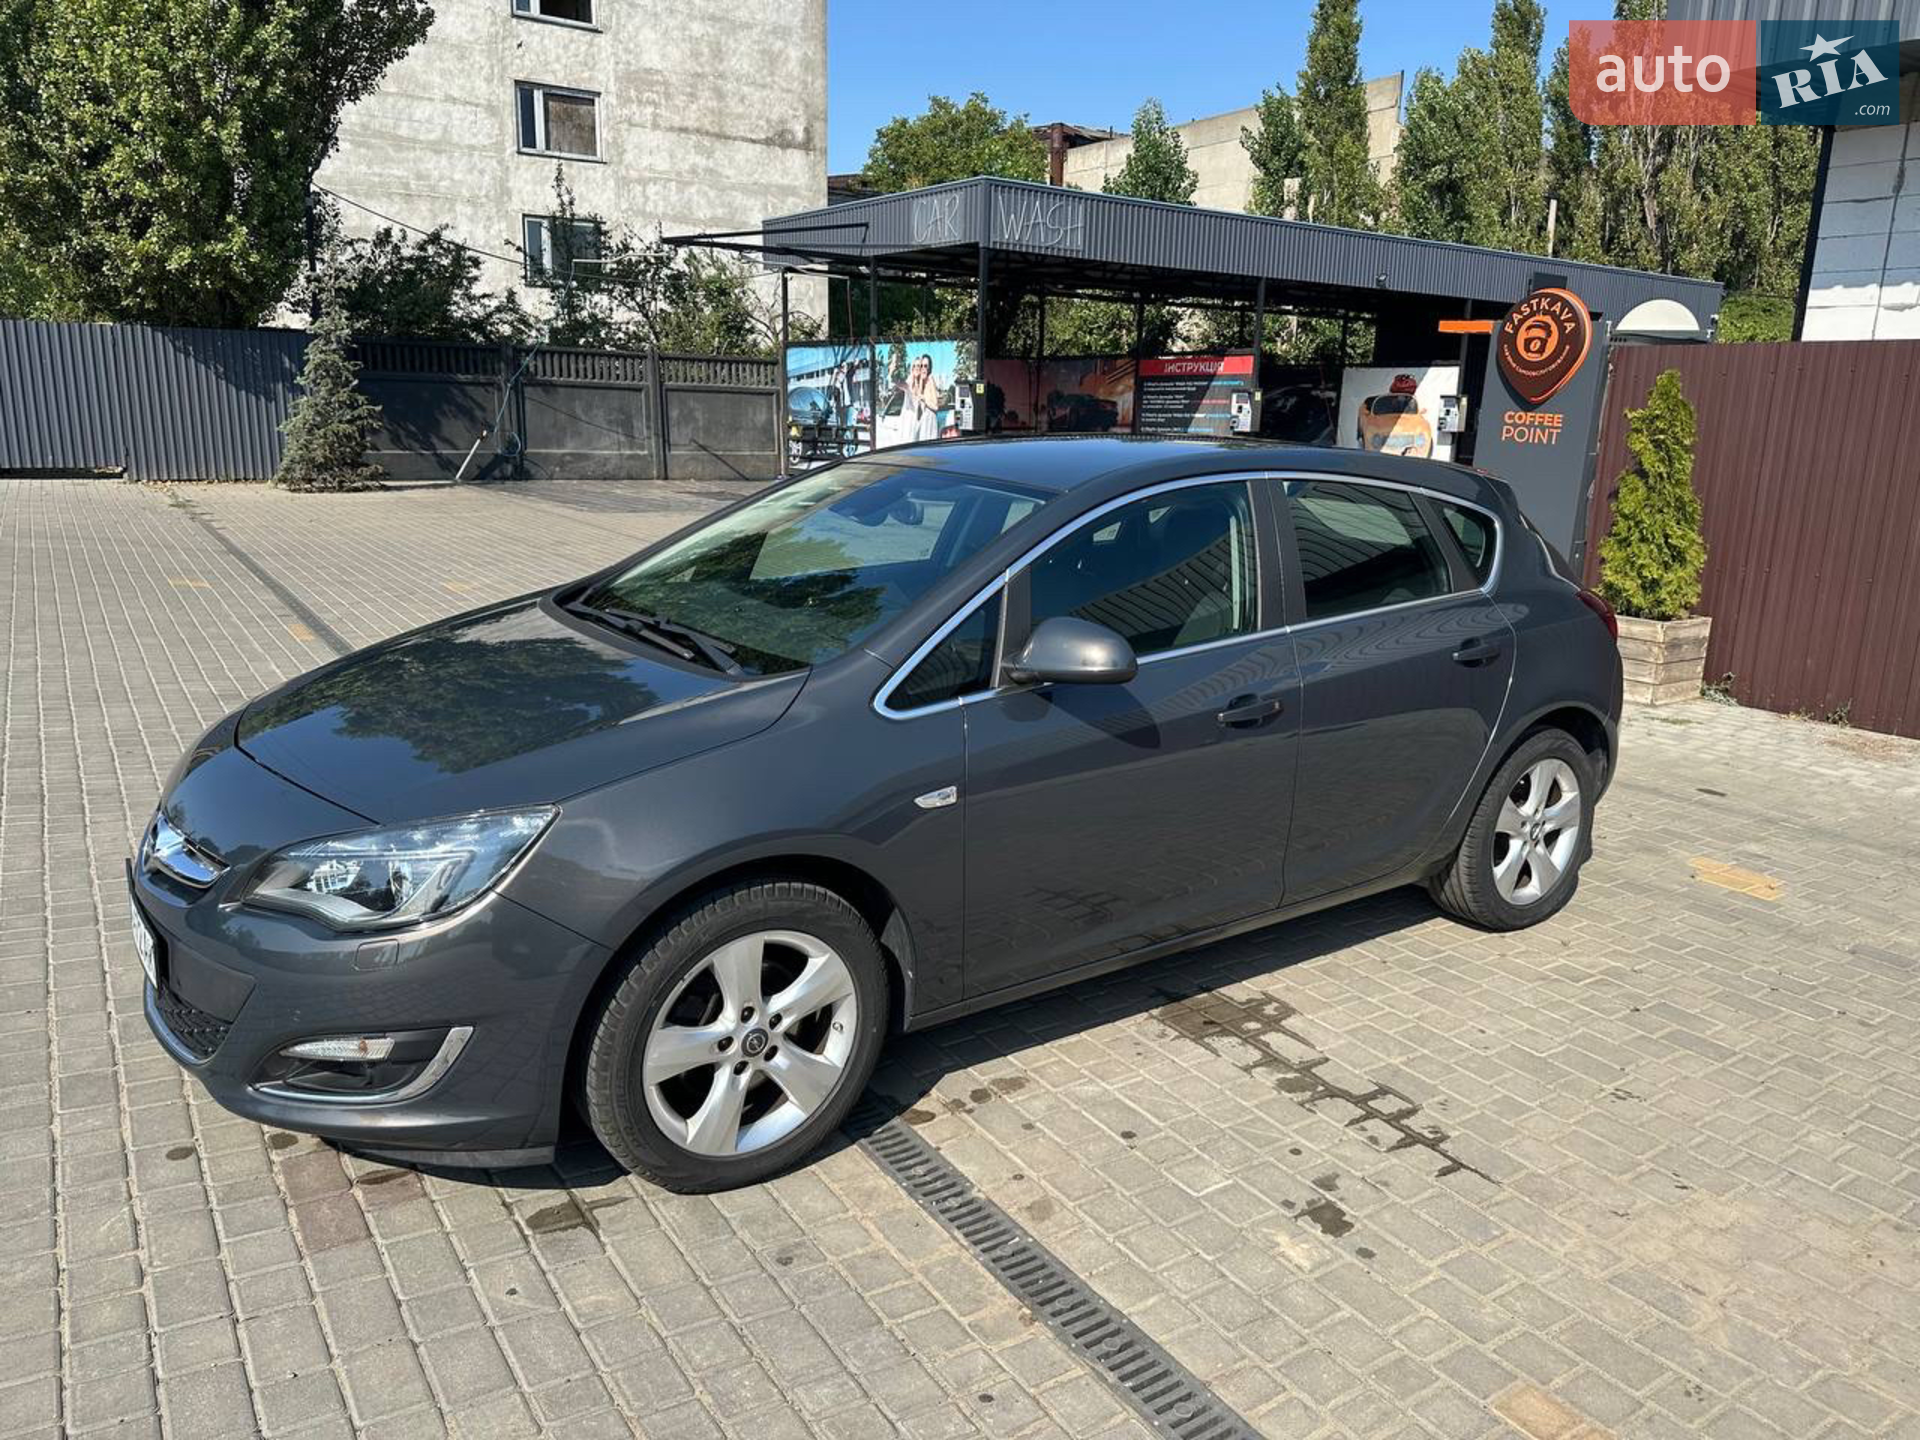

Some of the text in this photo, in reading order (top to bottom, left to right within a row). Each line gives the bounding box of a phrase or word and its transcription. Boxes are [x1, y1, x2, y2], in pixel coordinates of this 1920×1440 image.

[914, 194, 1085, 247] CAR WASH
[1505, 298, 1576, 334] FASTKAVA
[1504, 411, 1563, 426] COFFEE
[1501, 426, 1561, 444] POINT
